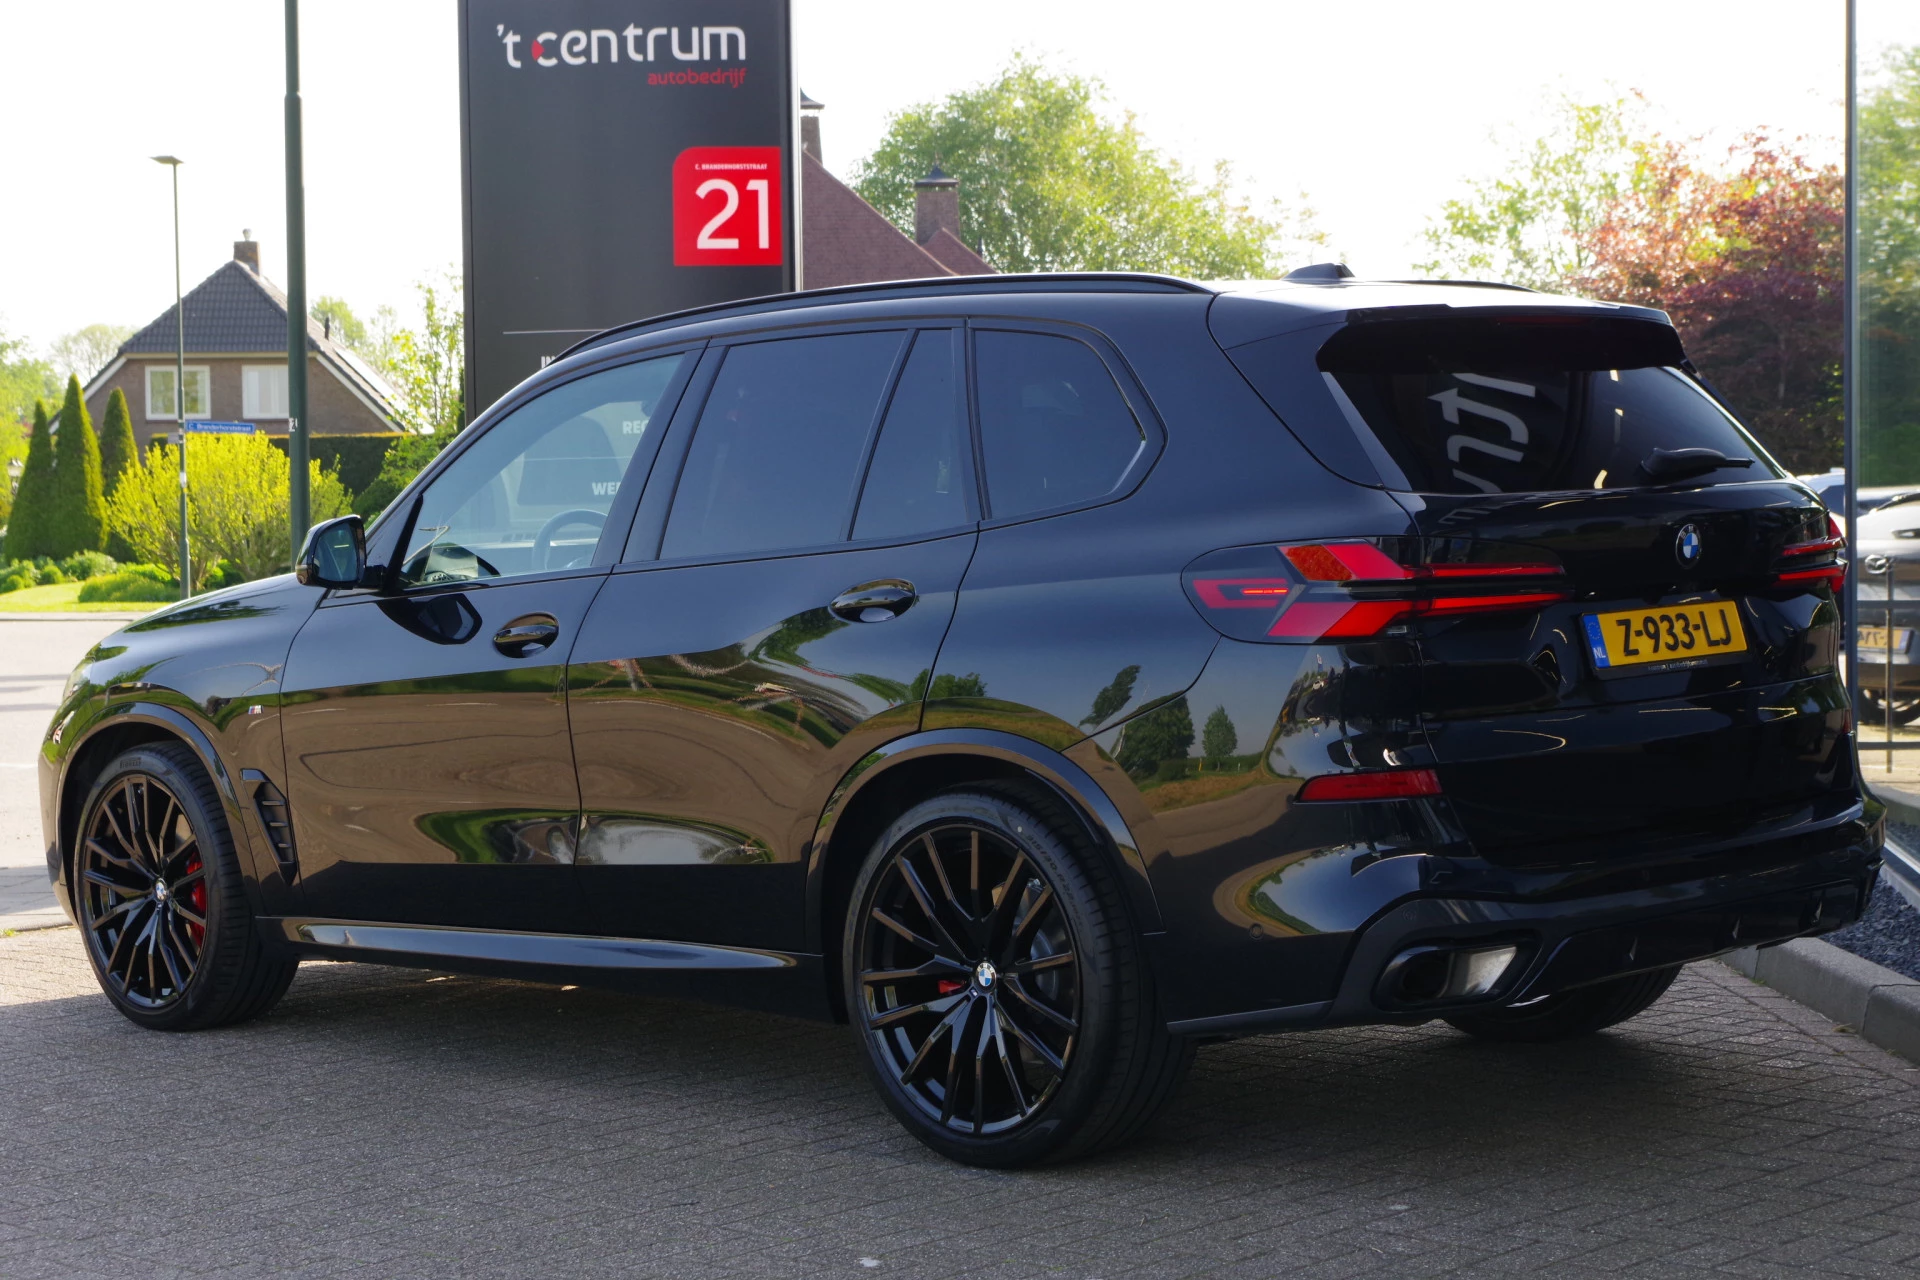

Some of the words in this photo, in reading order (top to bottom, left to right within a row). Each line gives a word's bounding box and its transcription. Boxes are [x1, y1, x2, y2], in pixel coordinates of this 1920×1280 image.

[496, 23, 522, 68] 't
[532, 22, 746, 67] centrum
[647, 68, 748, 88] autobedrijf
[695, 178, 769, 249] 21
[1593, 646, 1607, 658] NL
[1616, 609, 1732, 656] Z-933-LJ
